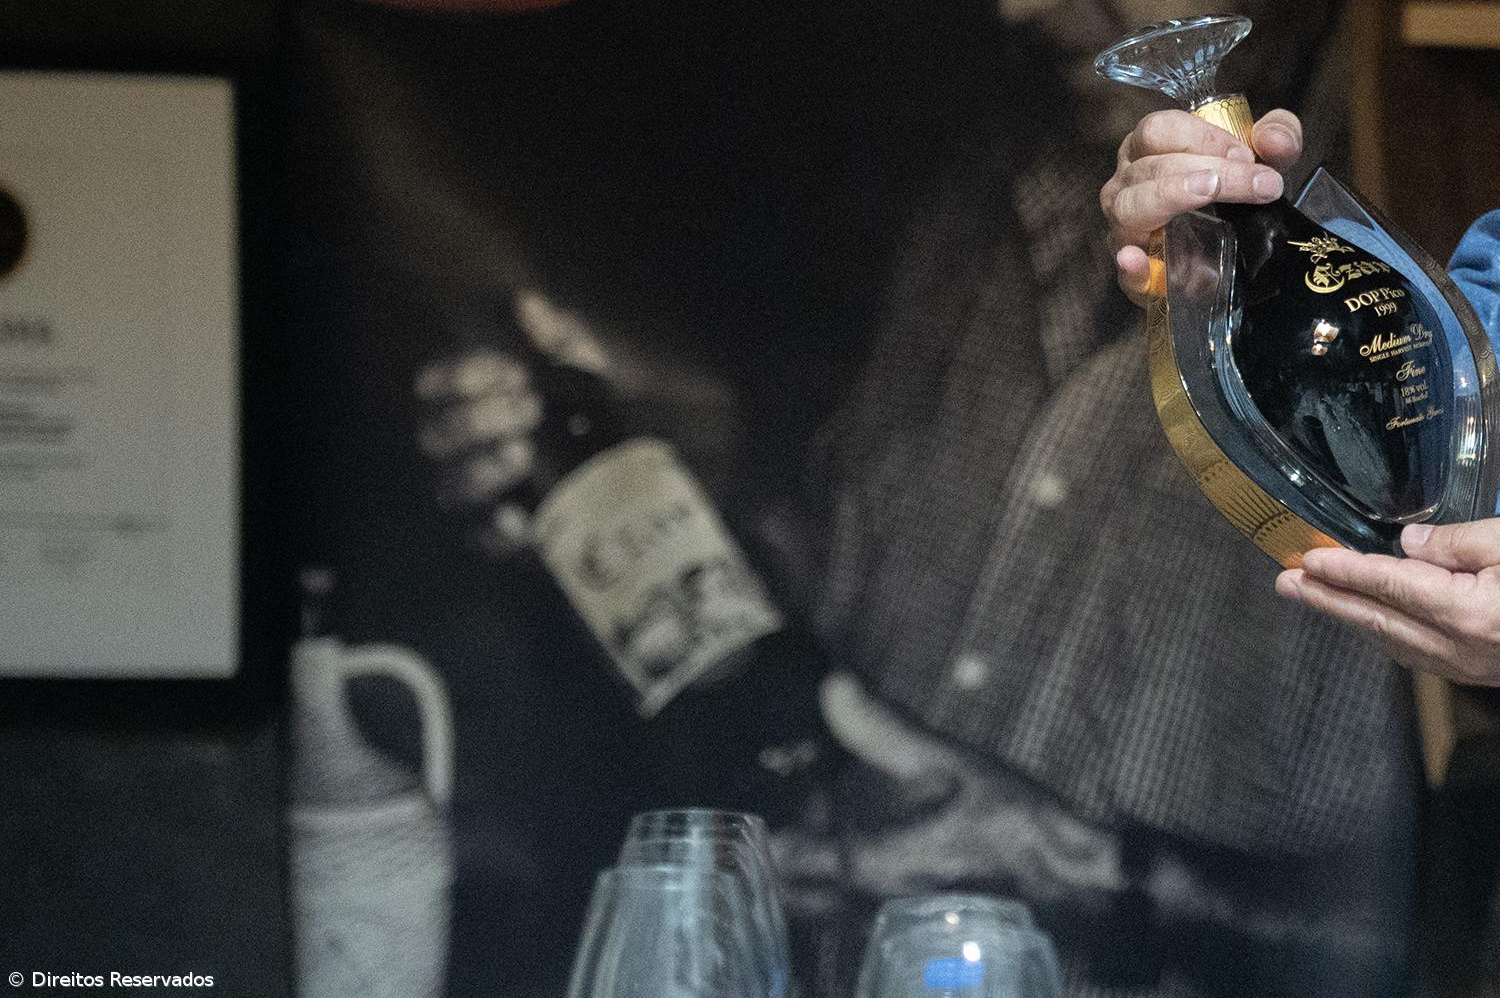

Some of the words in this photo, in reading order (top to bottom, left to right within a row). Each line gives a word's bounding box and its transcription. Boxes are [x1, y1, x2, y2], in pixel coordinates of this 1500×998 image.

[1304, 261, 1391, 294] Czar
[1344, 289, 1380, 313] DOP
[1380, 286, 1405, 301] Pico
[1374, 302, 1397, 317] 1999
[1360, 333, 1411, 357] Medium
